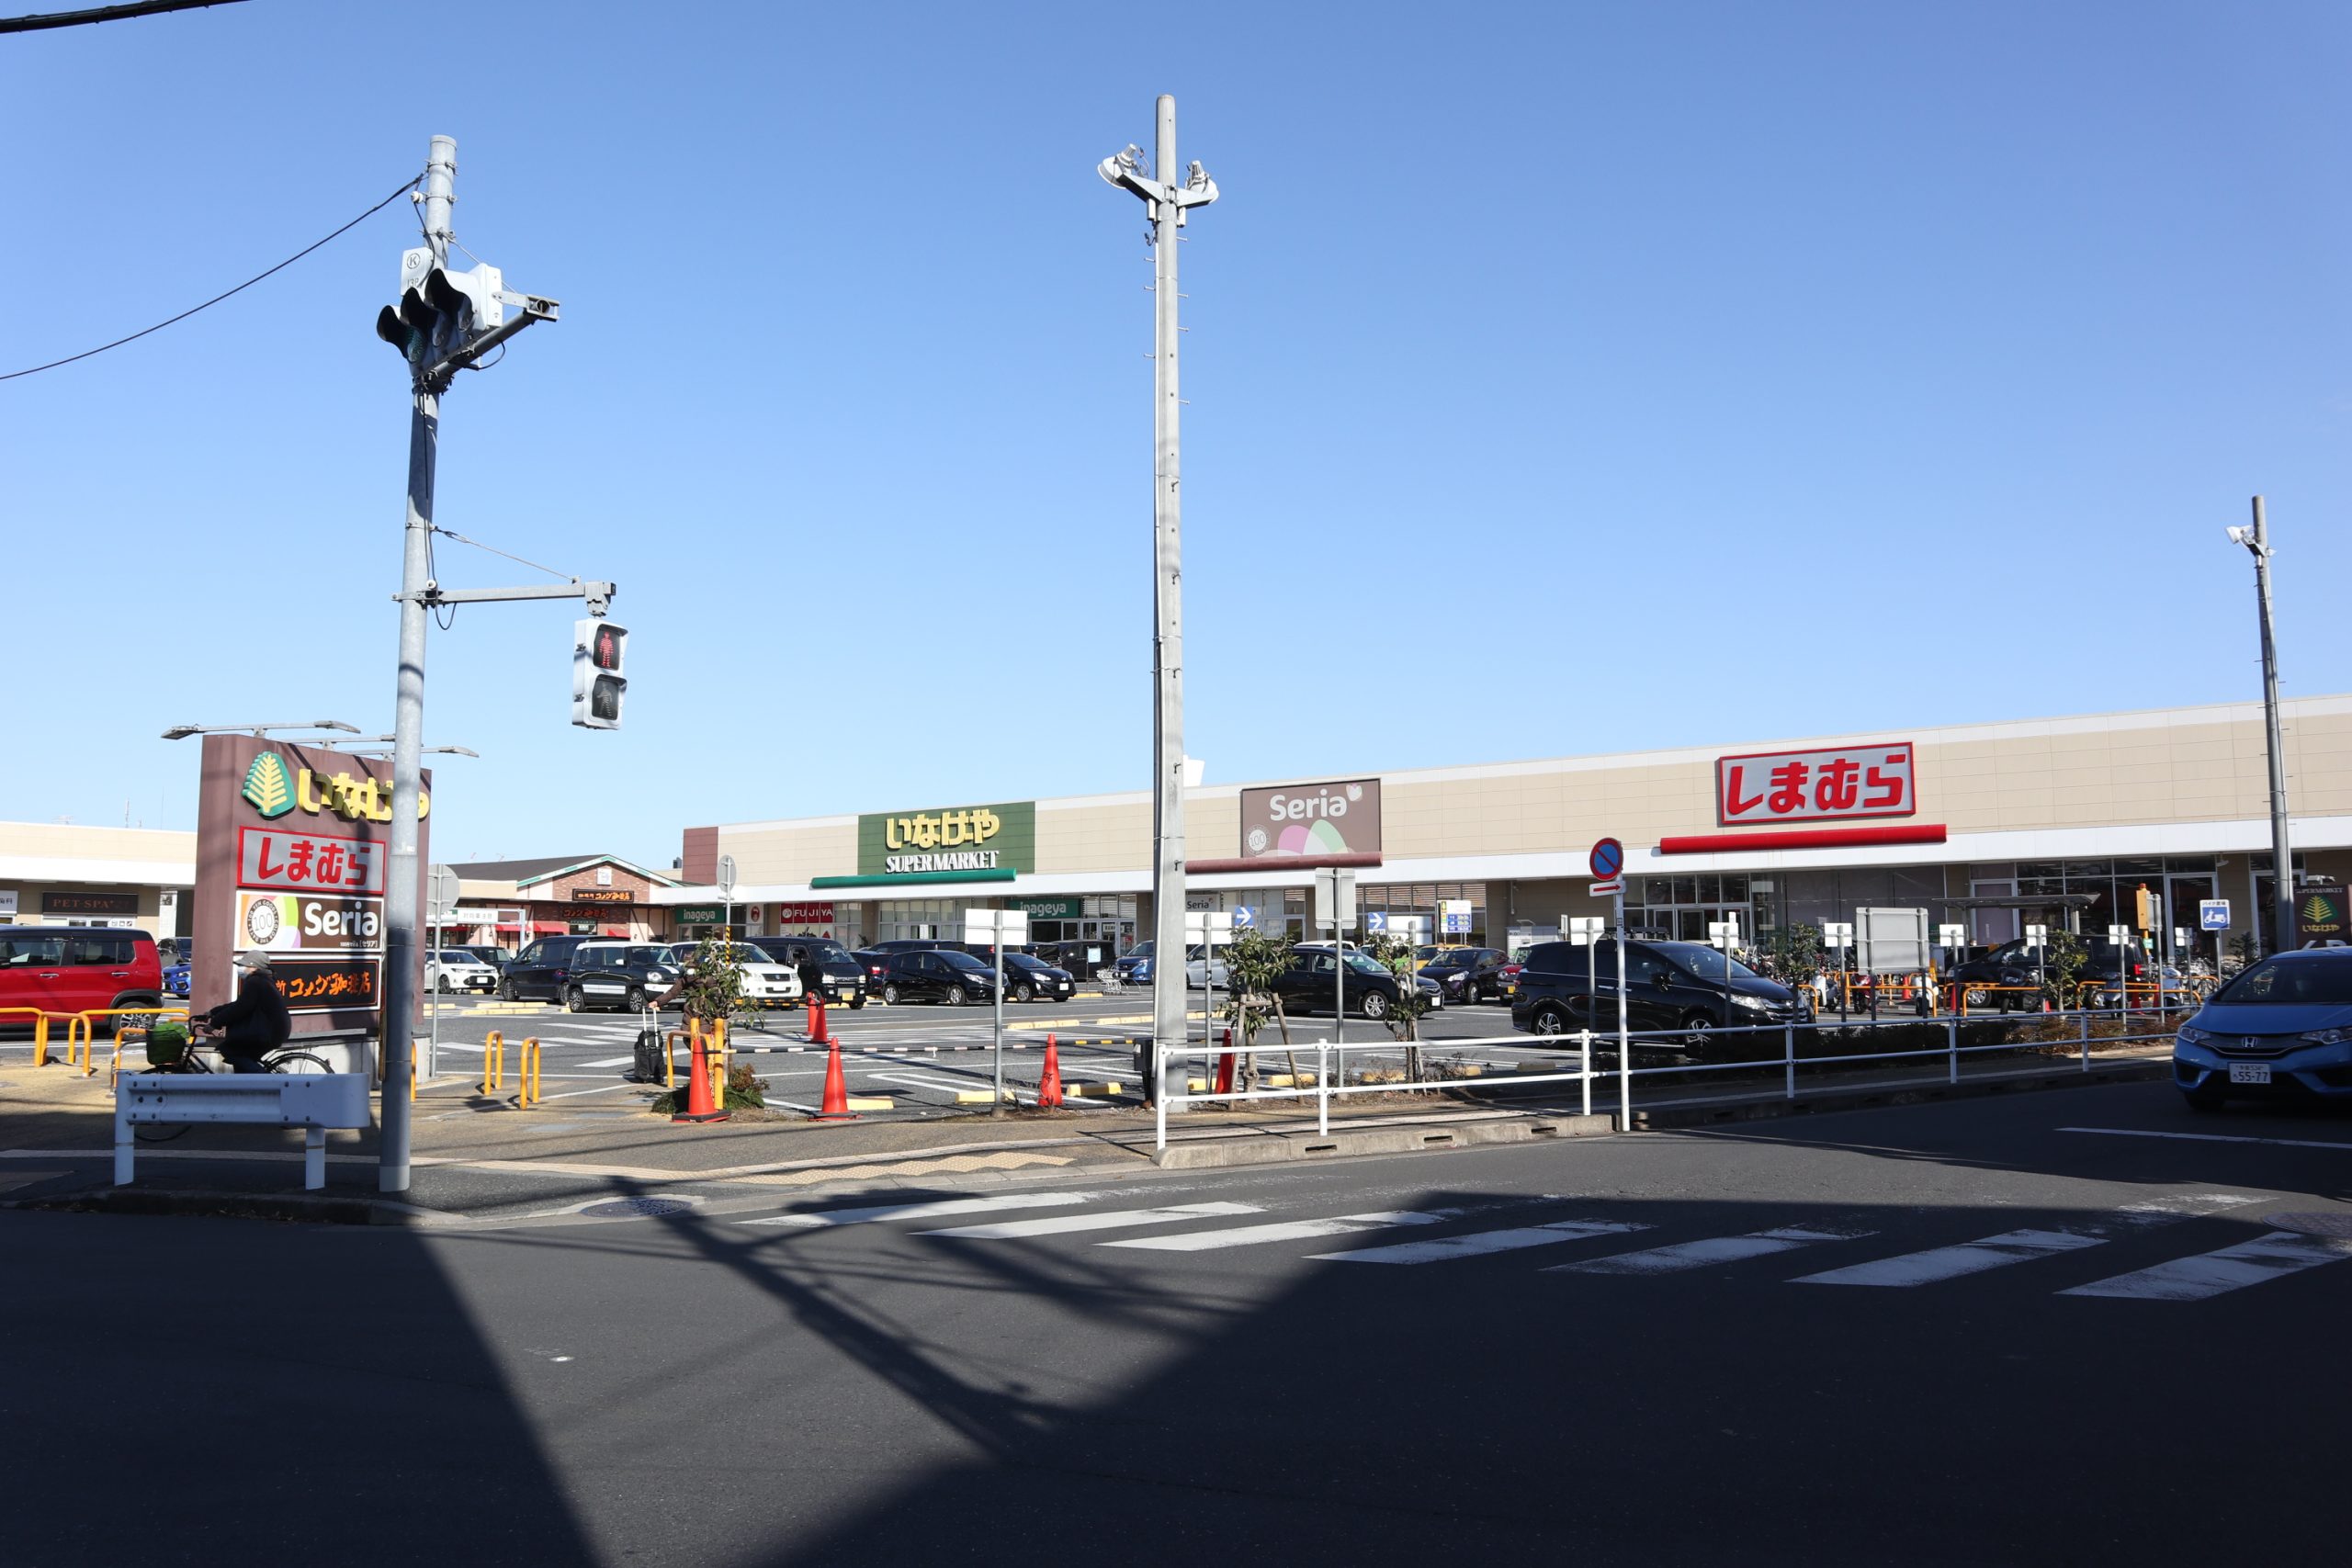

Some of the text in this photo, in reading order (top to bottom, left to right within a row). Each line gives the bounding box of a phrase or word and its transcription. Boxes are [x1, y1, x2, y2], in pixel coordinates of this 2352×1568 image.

[1728, 754, 1905, 815] しまむら
[1270, 788, 1347, 821] Seria
[258, 837, 370, 886] しまむら
[304, 901, 378, 936] Seria
[684, 909, 716, 921] inageya
[1020, 902, 1066, 917] inageya
[1186, 898, 1209, 909] Seria
